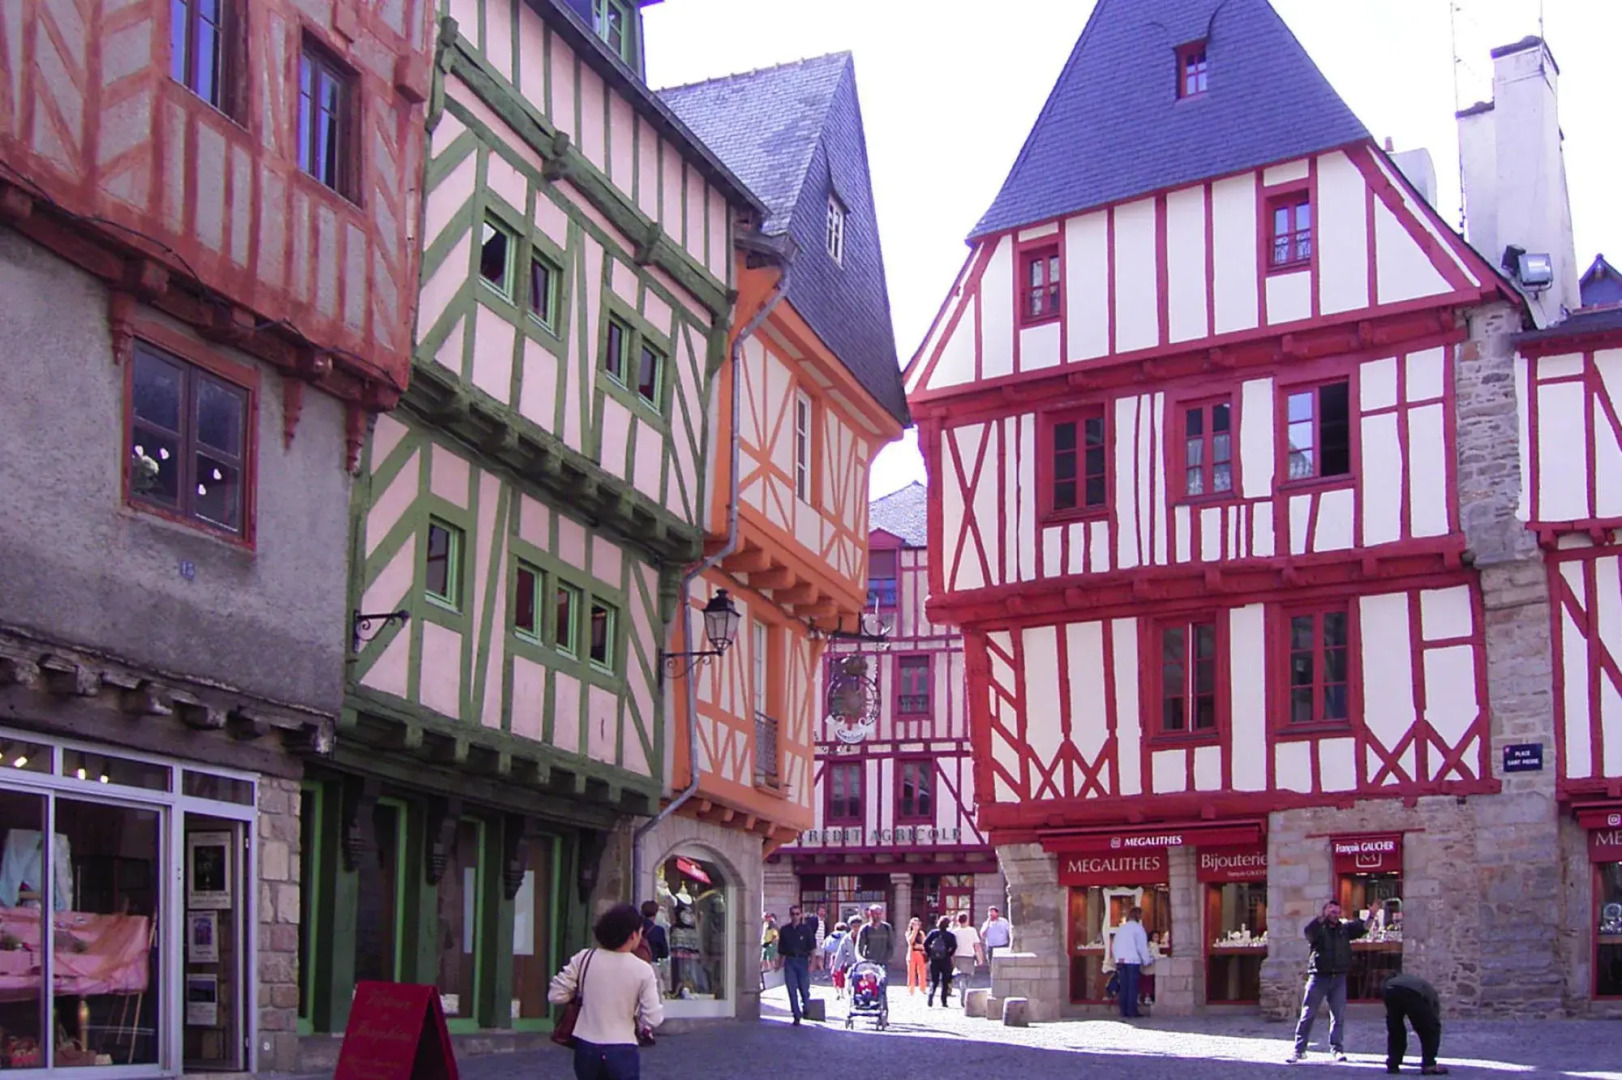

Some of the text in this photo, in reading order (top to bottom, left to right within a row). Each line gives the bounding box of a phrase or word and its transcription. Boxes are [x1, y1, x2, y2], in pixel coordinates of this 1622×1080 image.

[1124, 835, 1183, 847] MEGALITHES
[1361, 842, 1394, 852] GAUCHER
[1067, 855, 1161, 873] MEGALITHES
[1201, 851, 1267, 872] Bijouterie
